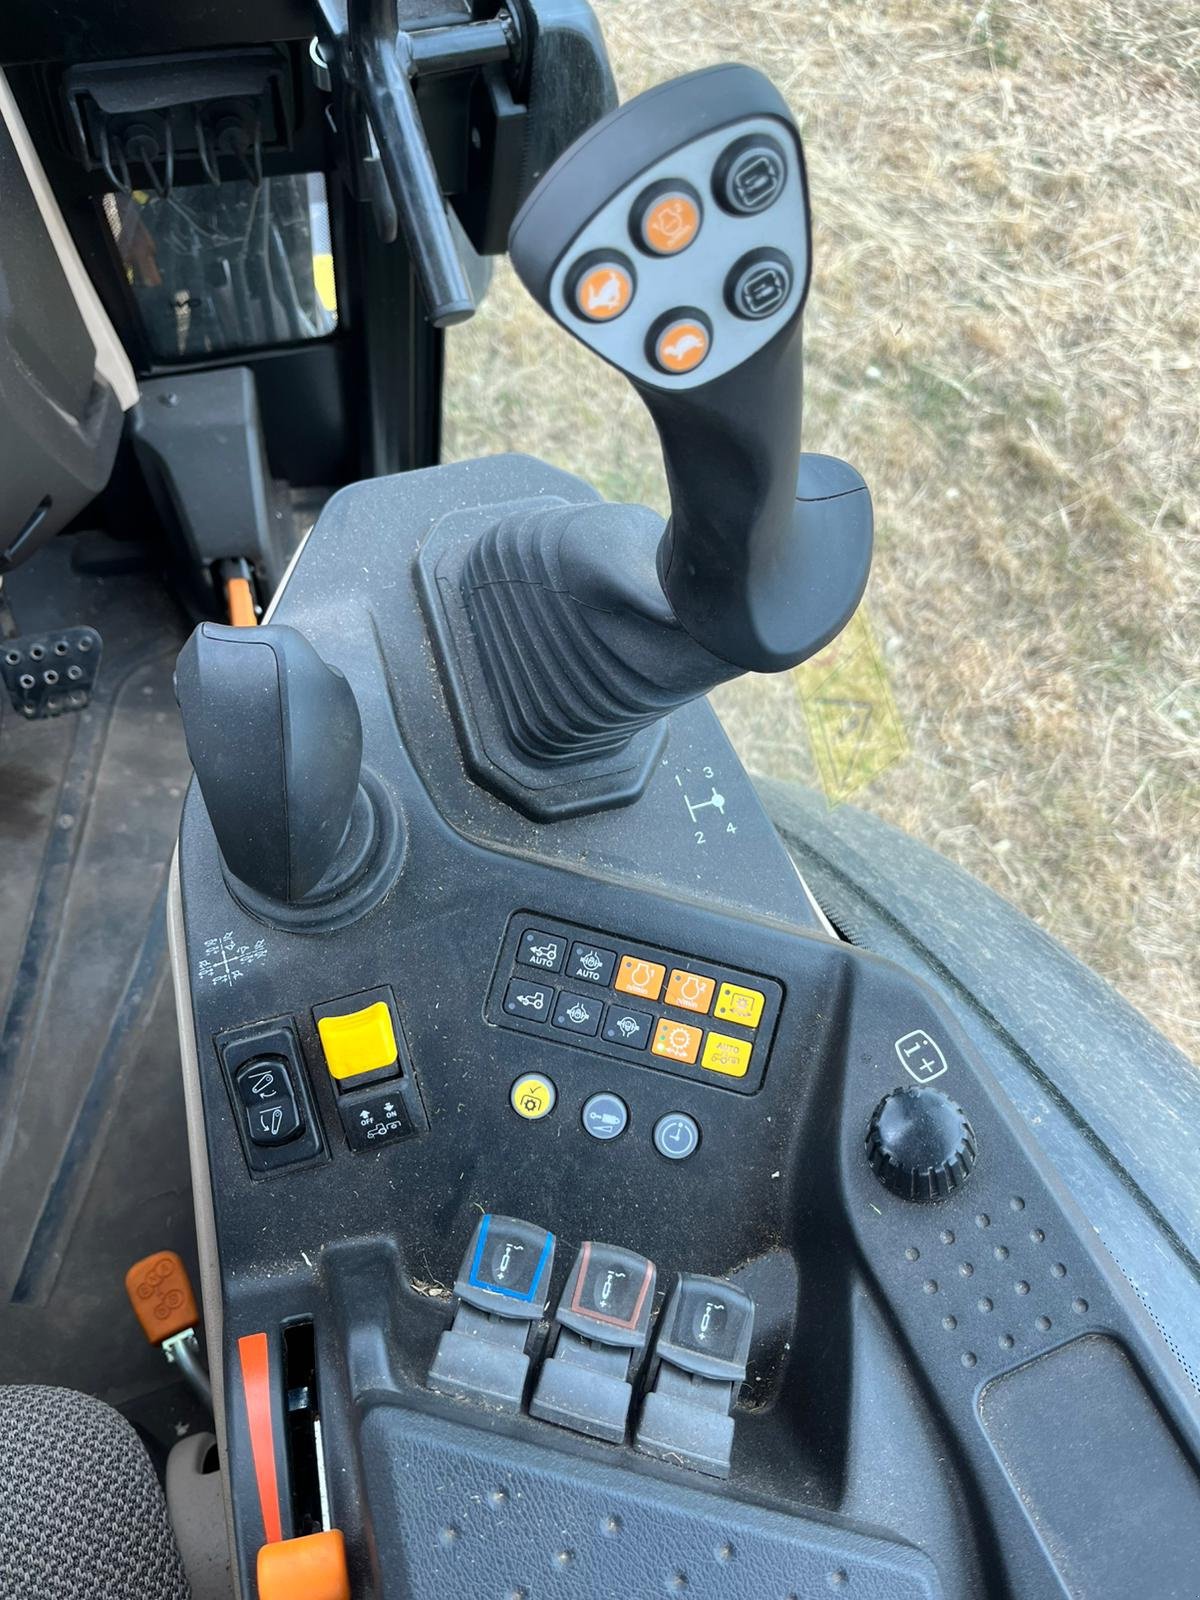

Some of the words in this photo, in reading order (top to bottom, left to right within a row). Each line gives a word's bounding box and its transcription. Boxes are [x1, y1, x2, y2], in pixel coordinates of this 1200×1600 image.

[703, 766, 714, 778] 3
[675, 774, 682, 786] 1
[726, 822, 737, 834] 4
[694, 831, 706, 844] 2
[529, 955, 553, 968] AUTO
[576, 968, 600, 980] AUTO
[716, 1042, 740, 1054] AUTO
[386, 1110, 397, 1119] ON
[361, 1117, 374, 1126] OFF
